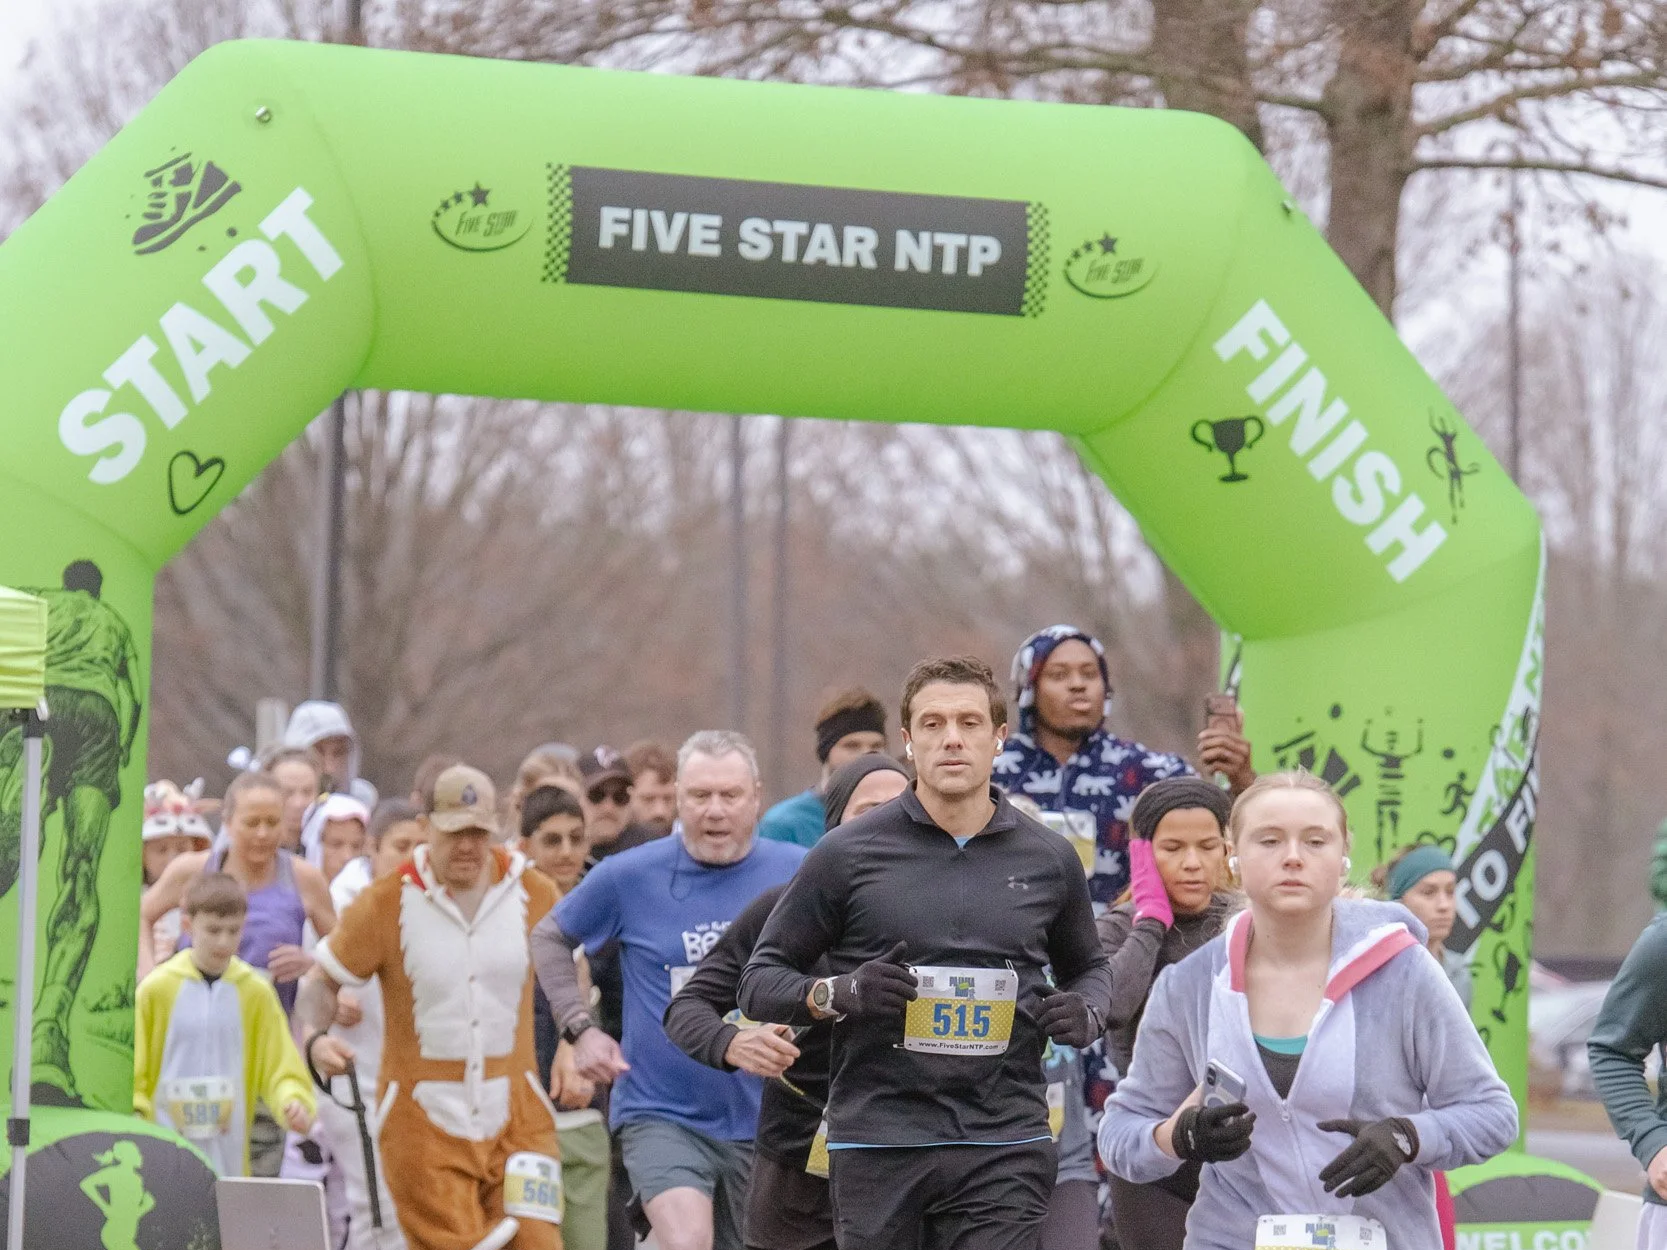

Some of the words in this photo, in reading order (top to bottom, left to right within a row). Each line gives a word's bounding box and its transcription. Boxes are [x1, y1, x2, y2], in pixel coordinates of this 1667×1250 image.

[599, 206, 723, 257] FIVE
[738, 217, 878, 269] STAR
[894, 229, 1002, 277] NTP
[58, 186, 344, 485] START
[1212, 298, 1448, 584] FINISH
[918, 1041, 999, 1051] www.FiveStarNTP.com
[933, 1003, 991, 1037] 515
